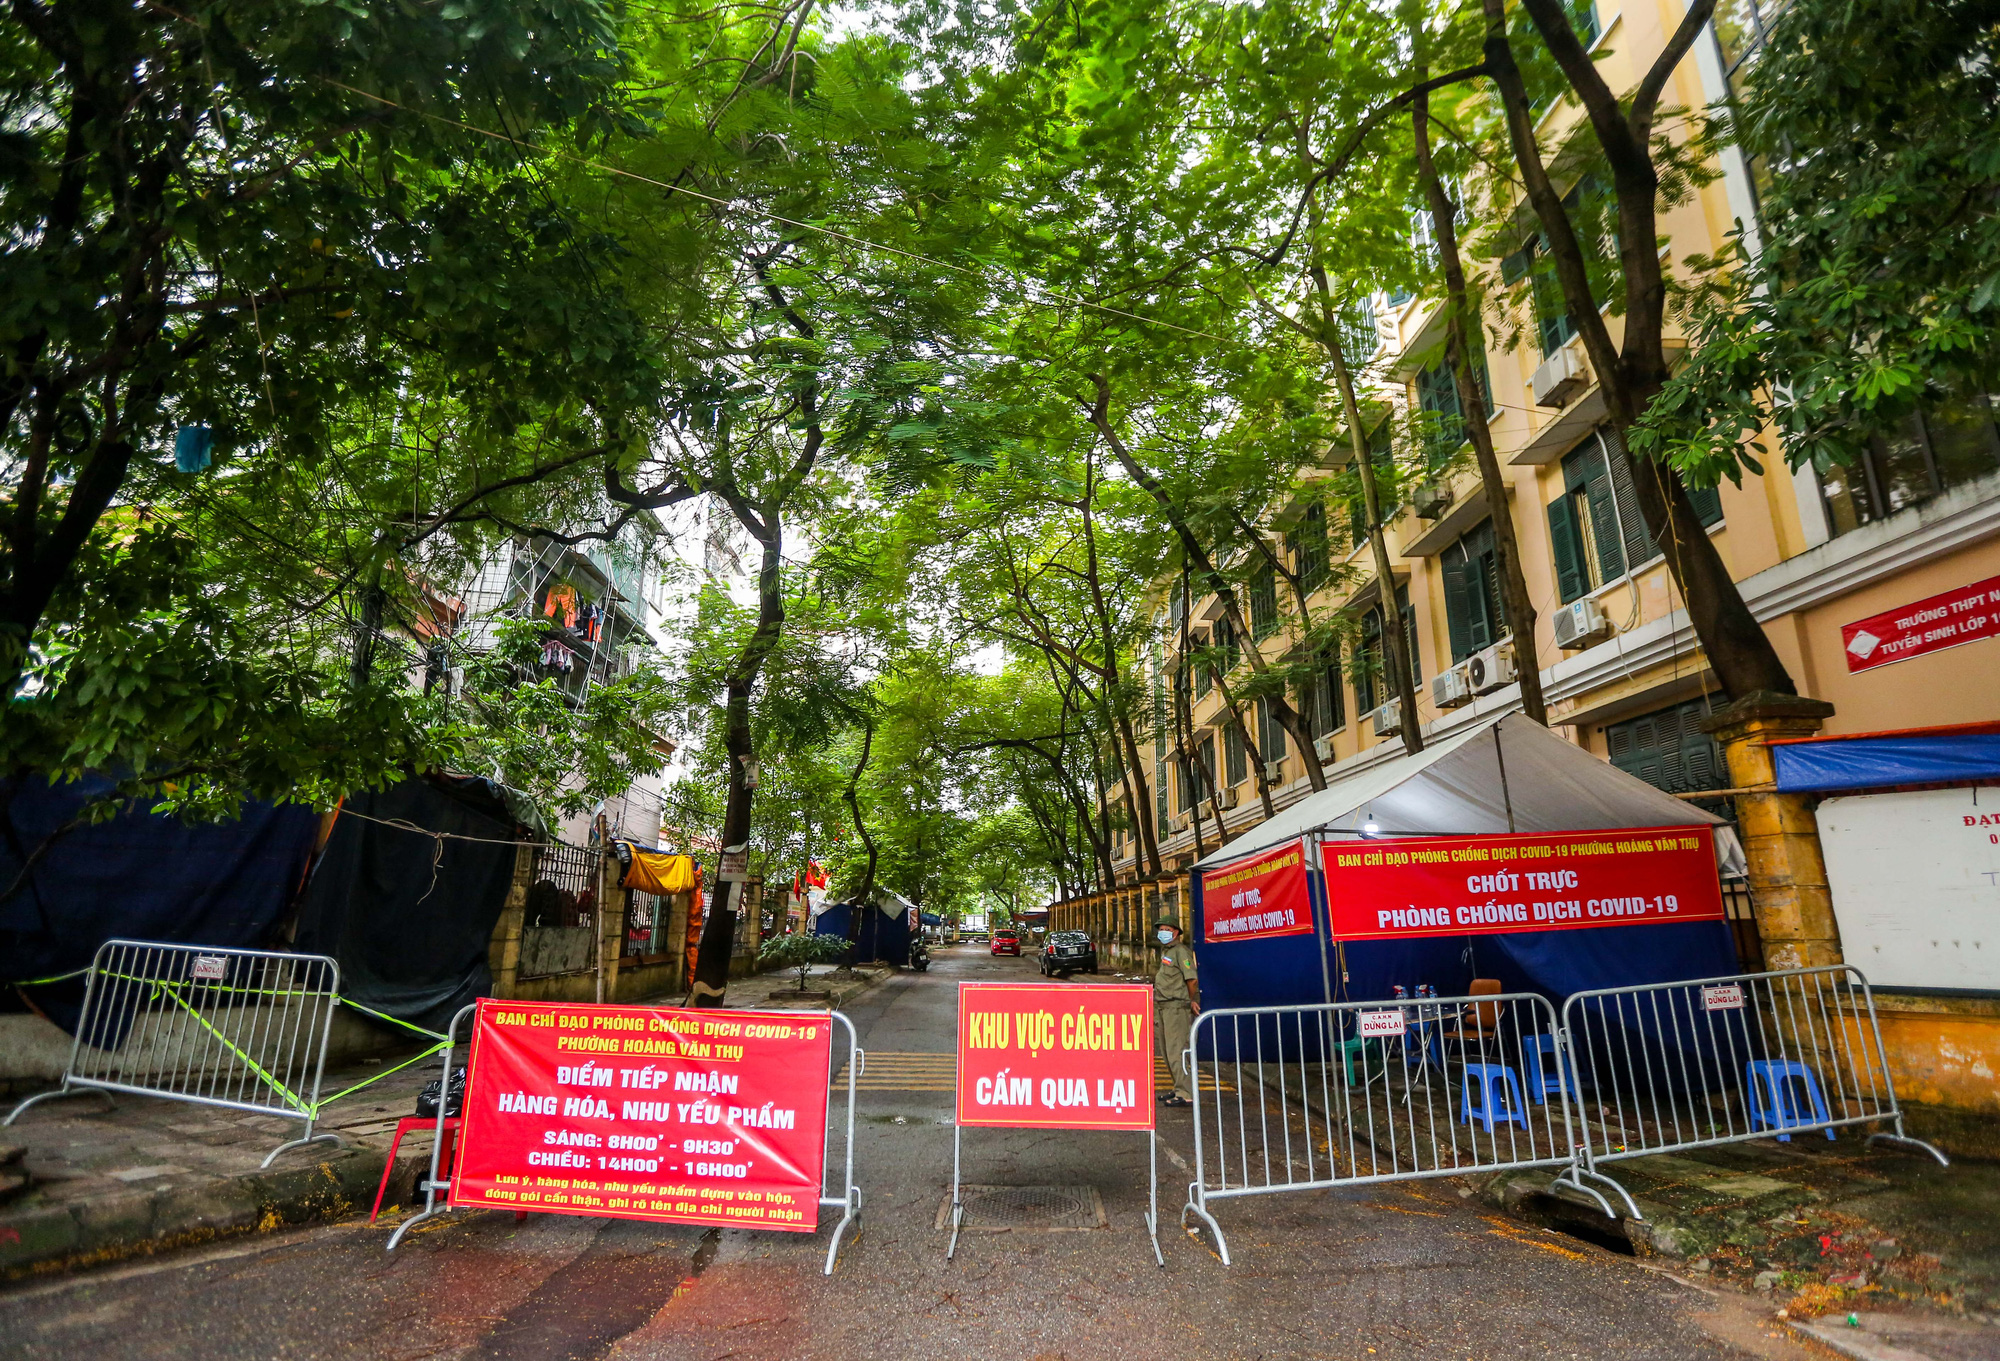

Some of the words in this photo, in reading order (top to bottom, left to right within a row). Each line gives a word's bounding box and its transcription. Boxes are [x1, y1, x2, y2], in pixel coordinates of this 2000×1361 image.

[1894, 606, 1948, 630] TRƯỜNG
[1949, 594, 1985, 614] THPT
[1880, 631, 1922, 655] TUYỂN
[1924, 623, 1957, 643] SINH
[1958, 616, 1987, 633] LỚP
[1990, 612, 2000, 625] 1
[1337, 854, 1361, 867] BAN
[1364, 850, 1383, 866] CHỈ
[1386, 852, 1409, 867] ĐẠO
[1411, 849, 1449, 864] PHÒNG
[1452, 845, 1488, 862] CHỐNG
[1492, 847, 1517, 863] DỊCH
[1520, 844, 1568, 859] COVID-19
[1571, 840, 1614, 856] PHƯỜNG
[1616, 838, 1653, 854] HOÀNG
[1655, 837, 1678, 851] VĂN
[1679, 837, 1699, 851] THỤ
[1989, 833, 2000, 845] 0
[1467, 868, 1519, 893] CHỐT
[1525, 869, 1578, 892] TRỰC
[1377, 904, 1450, 928] PHÒNG
[1456, 899, 1527, 924] CHỐNG
[1533, 900, 1582, 923] DỊCH
[1587, 895, 1678, 917] COVID-19
[1708, 995, 1727, 1004] DỪNG
[1728, 995, 1740, 1003] LẠI
[496, 1012, 526, 1025] BAN
[530, 1011, 555, 1027] CHỈ
[559, 1015, 589, 1031] ĐẠO
[593, 1014, 645, 1031] PHÒNG
[649, 1016, 699, 1034] CHỐNG
[704, 1022, 741, 1038] DỊCH
[745, 1024, 817, 1040] COVID-19
[969, 1012, 1009, 1049] KHU
[1015, 1009, 1055, 1058] VỰC
[1061, 1005, 1115, 1050] CÁCH
[1121, 1014, 1143, 1051] LY
[1364, 1020, 1387, 1031] DỪNG
[1388, 1021, 1402, 1030] LẠI
[558, 1035, 619, 1052] PHƯỜNG
[623, 1038, 675, 1054] HOÀNG
[680, 1040, 710, 1057] VĂN
[715, 1044, 744, 1061] THỤ
[557, 1060, 613, 1087] ĐIỂM
[620, 1064, 668, 1089] TIẾP
[674, 1070, 738, 1096] NHẬN
[976, 1068, 1032, 1106] CẤM
[1041, 1078, 1090, 1109] QUA
[1097, 1079, 1135, 1113] LẠI
[498, 1091, 558, 1115] HÀNG
[563, 1095, 616, 1120] HÓA,
[622, 1101, 670, 1122] NHU
[677, 1099, 721, 1124] YẾU
[726, 1101, 795, 1129] PHẨM
[544, 1129, 602, 1148] SÁNG:
[528, 1150, 591, 1168] CHIỀU:
[485, 1188, 516, 1201] đóng
[520, 1190, 540, 1202] gói
[544, 1191, 568, 1203] cẩn
[572, 1194, 604, 1207] thận,
[608, 1197, 629, 1209] ghi
[633, 1199, 647, 1209] rõ
[650, 1200, 671, 1211] tên
[675, 1202, 696, 1214] địa
[701, 1203, 722, 1214] chỉ
[726, 1206, 764, 1218] người
[768, 1209, 803, 1221] nhận
[495, 1174, 519, 1184] Lưu
[522, 1175, 533, 1186] ý,
[537, 1176, 569, 1189] hàng
[572, 1179, 600, 1191] hóa,
[603, 1182, 629, 1192] nhu
[632, 1182, 656, 1194] yếu
[659, 1184, 696, 1197] phẩm
[700, 1188, 733, 1200] đựng
[738, 1190, 762, 1201] vào
[766, 1191, 795, 1205] hộp,
